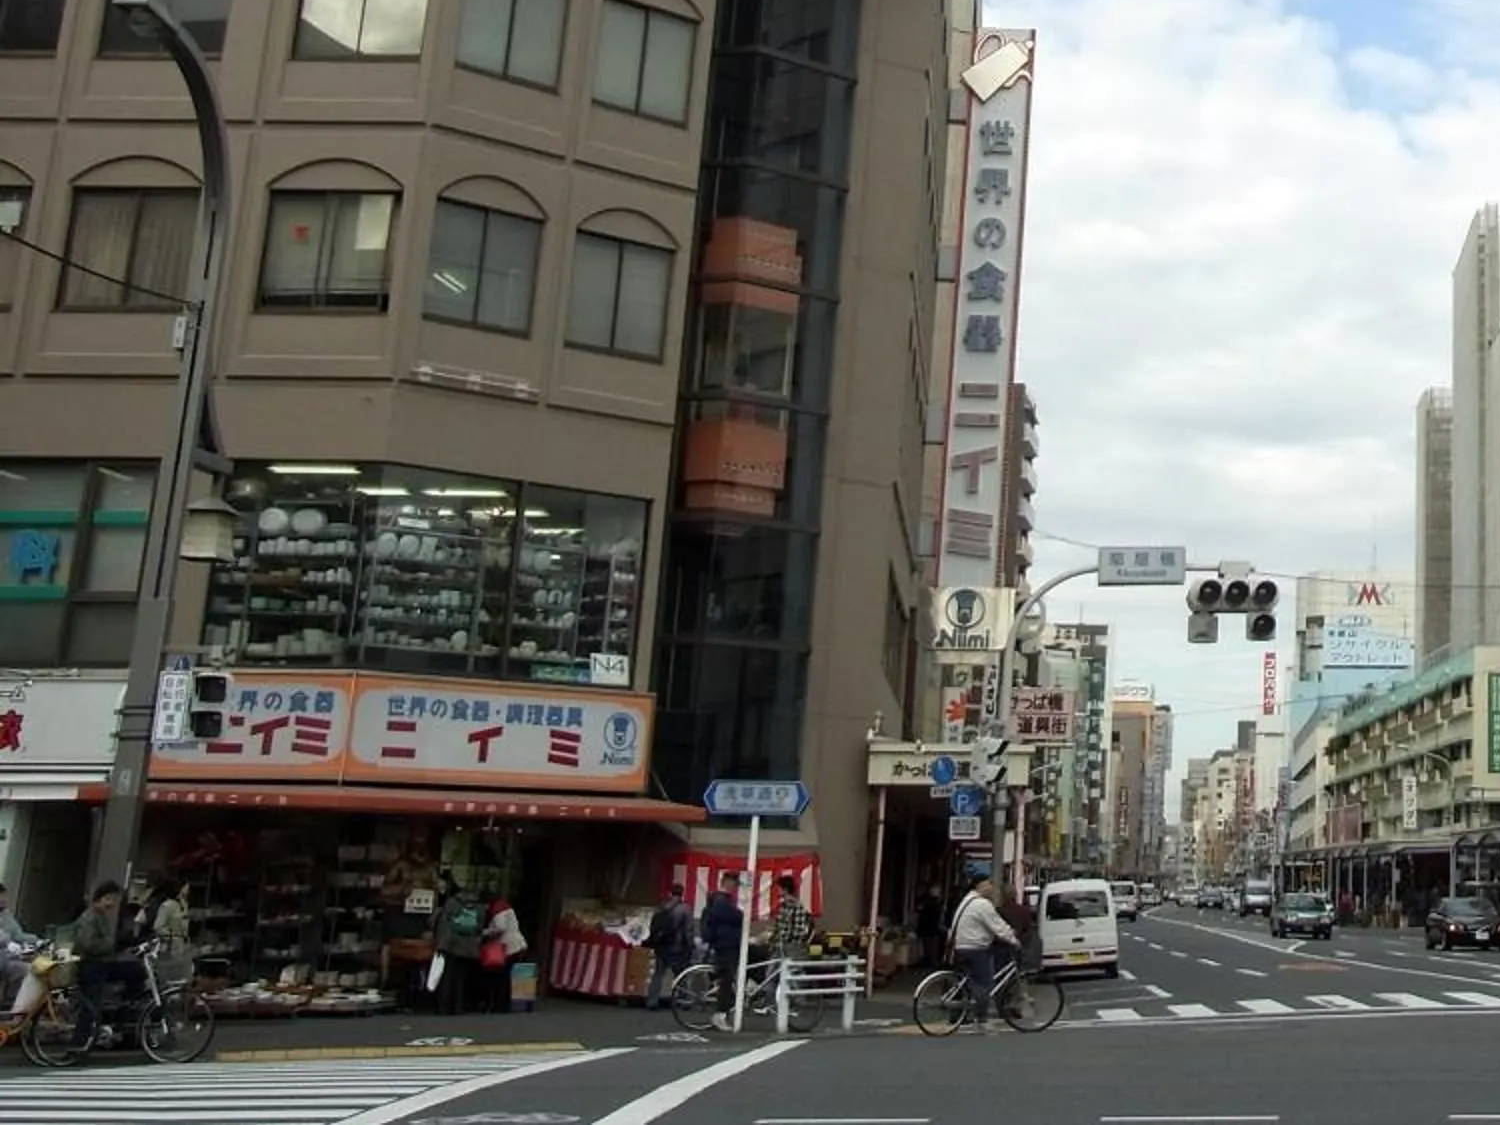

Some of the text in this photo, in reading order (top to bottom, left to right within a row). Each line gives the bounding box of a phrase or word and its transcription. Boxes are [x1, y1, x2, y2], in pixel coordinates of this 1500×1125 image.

[946, 382, 998, 559] ニイミ
[937, 629, 990, 648] Niimi
[231, 690, 335, 713] 界の食器
[381, 720, 582, 768] ニイミ
